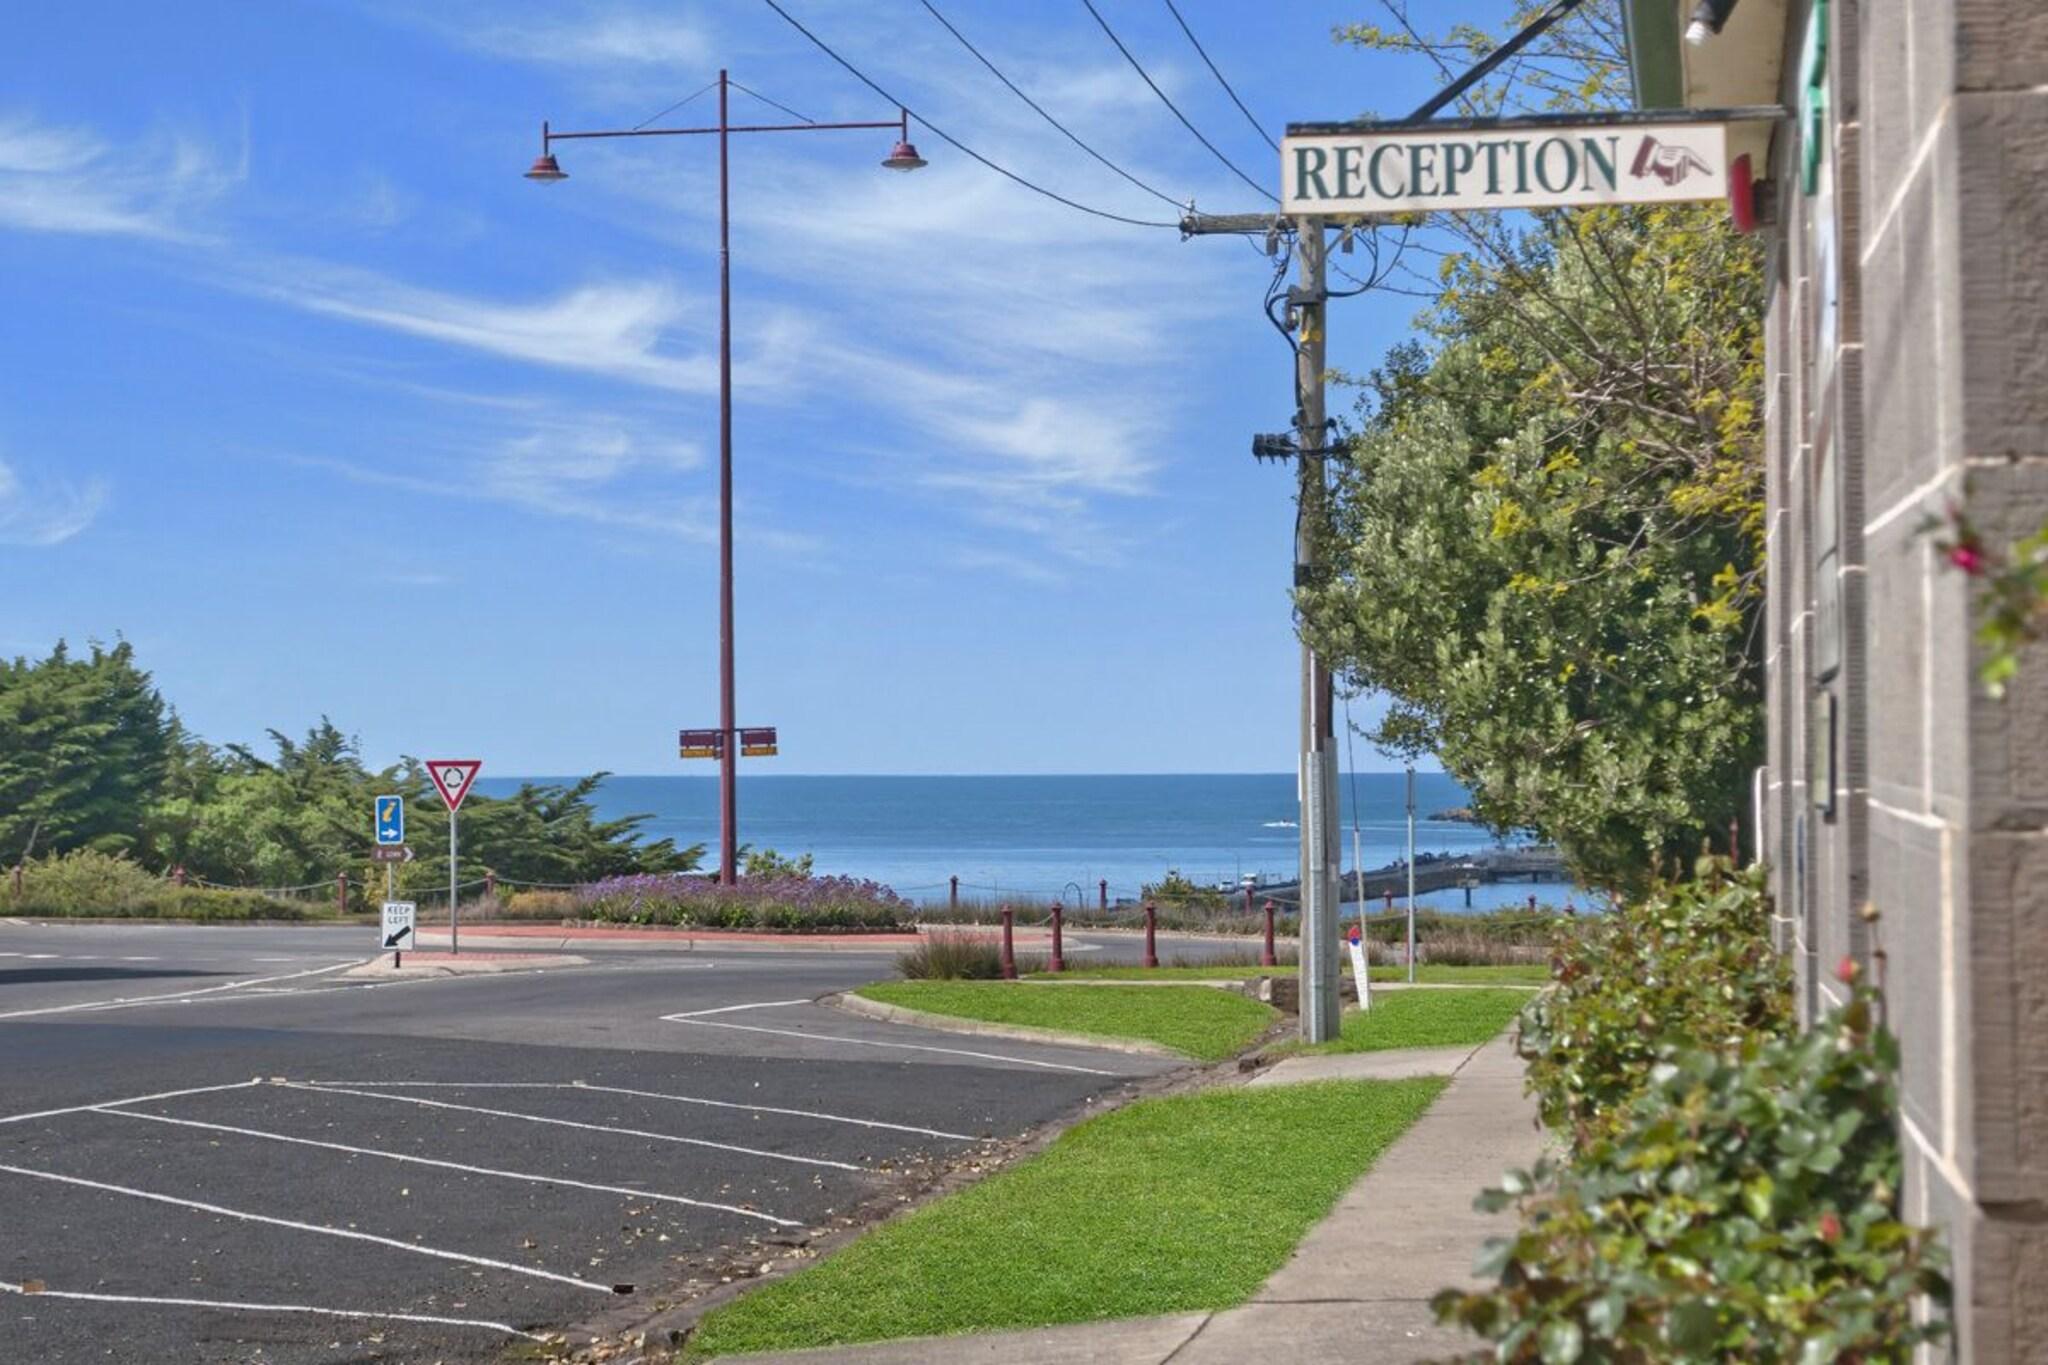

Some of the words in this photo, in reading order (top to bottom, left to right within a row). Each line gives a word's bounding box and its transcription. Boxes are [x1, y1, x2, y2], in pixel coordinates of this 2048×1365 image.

[1292, 135, 1619, 201] RECEPTION
[387, 906, 410, 915] KEEP
[387, 916, 409, 925] LEFT
